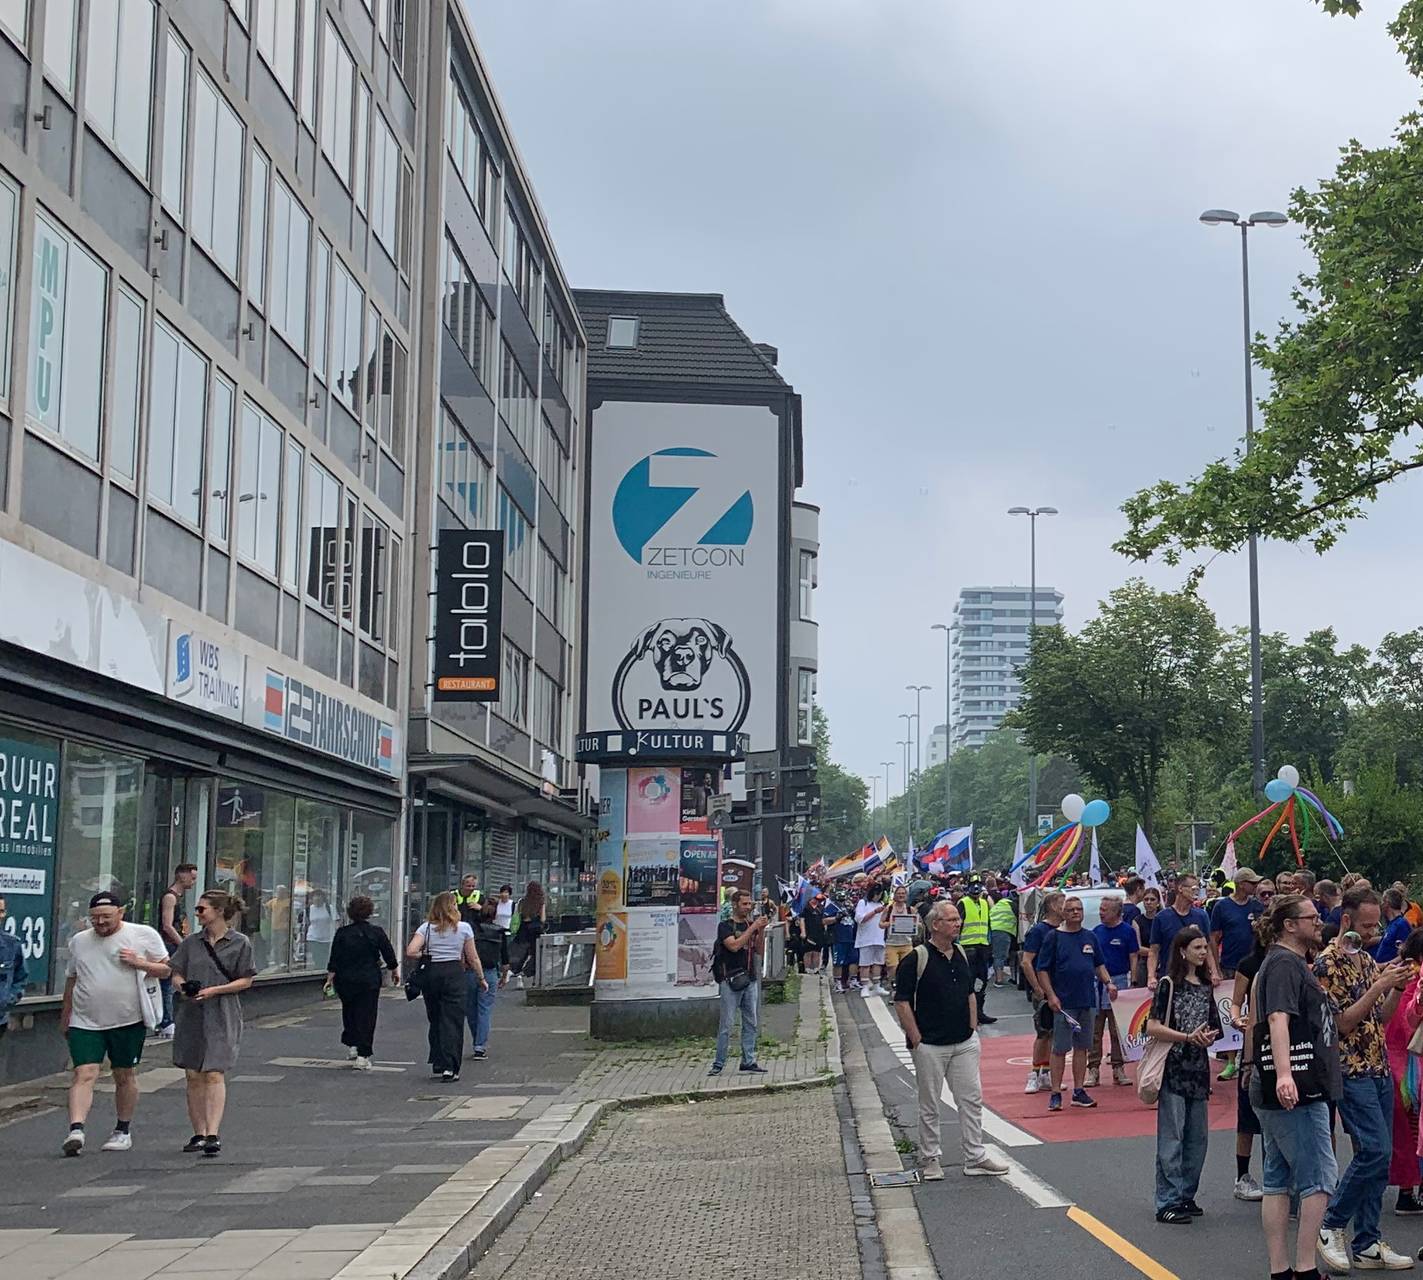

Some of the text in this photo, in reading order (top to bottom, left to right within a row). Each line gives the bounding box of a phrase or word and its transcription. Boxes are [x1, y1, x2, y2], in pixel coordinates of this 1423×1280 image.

[37, 238, 59, 413] MPU
[647, 547, 745, 567] ZETCON
[647, 570, 712, 580] INGENIEURE
[449, 542, 490, 667] tablo
[199, 639, 220, 671] WBS
[199, 671, 240, 709] TRAINING
[442, 678, 491, 691] RESTAURANT
[632, 731, 704, 751] KULTUR
[0, 753, 55, 798] RUHR
[0, 797, 52, 843] REAL
[12, 841, 52, 857] Immobilien
[683, 849, 706, 859] OPEN
